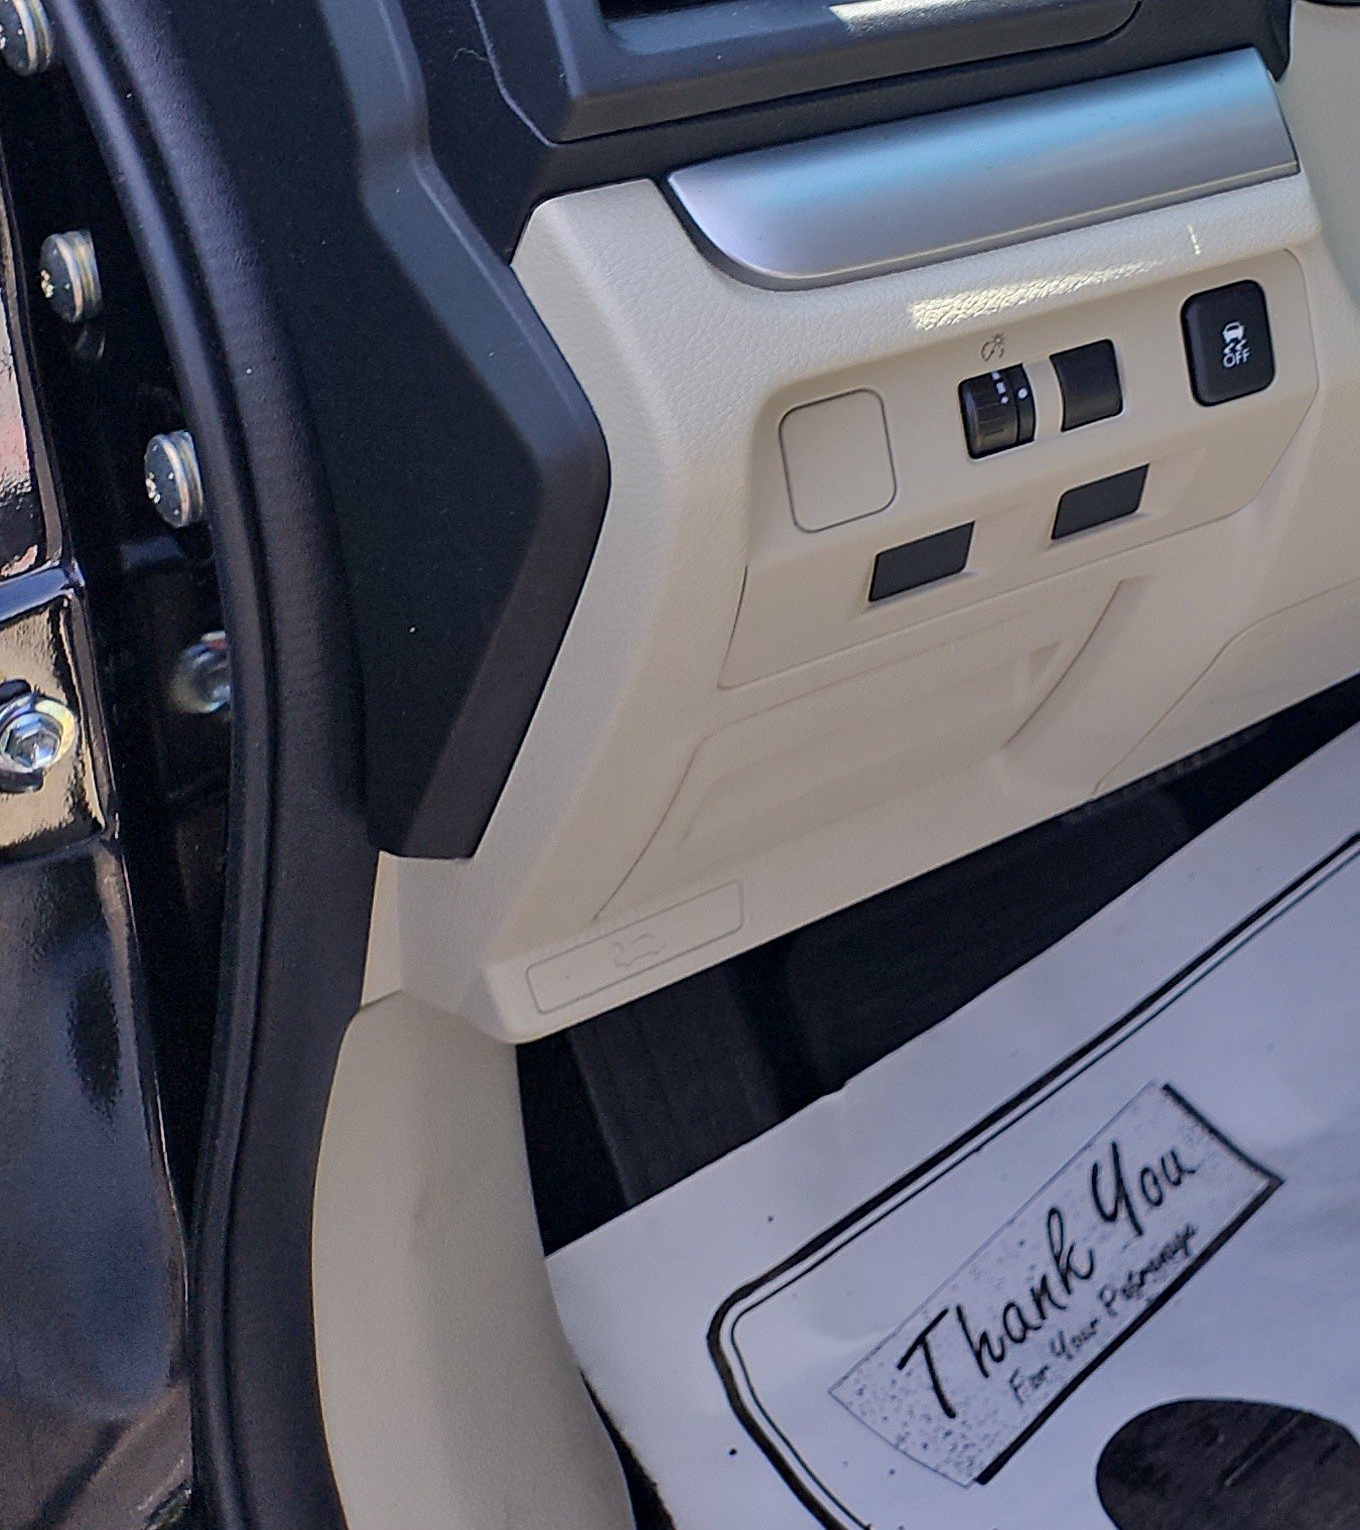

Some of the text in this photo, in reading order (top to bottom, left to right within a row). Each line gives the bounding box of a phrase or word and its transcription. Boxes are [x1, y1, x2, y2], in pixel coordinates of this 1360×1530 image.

[1223, 347, 1250, 368] OFF
[898, 1141, 1199, 1419] Thank You
[1008, 1365, 1049, 1406] For
[1048, 1318, 1099, 1361] Your
